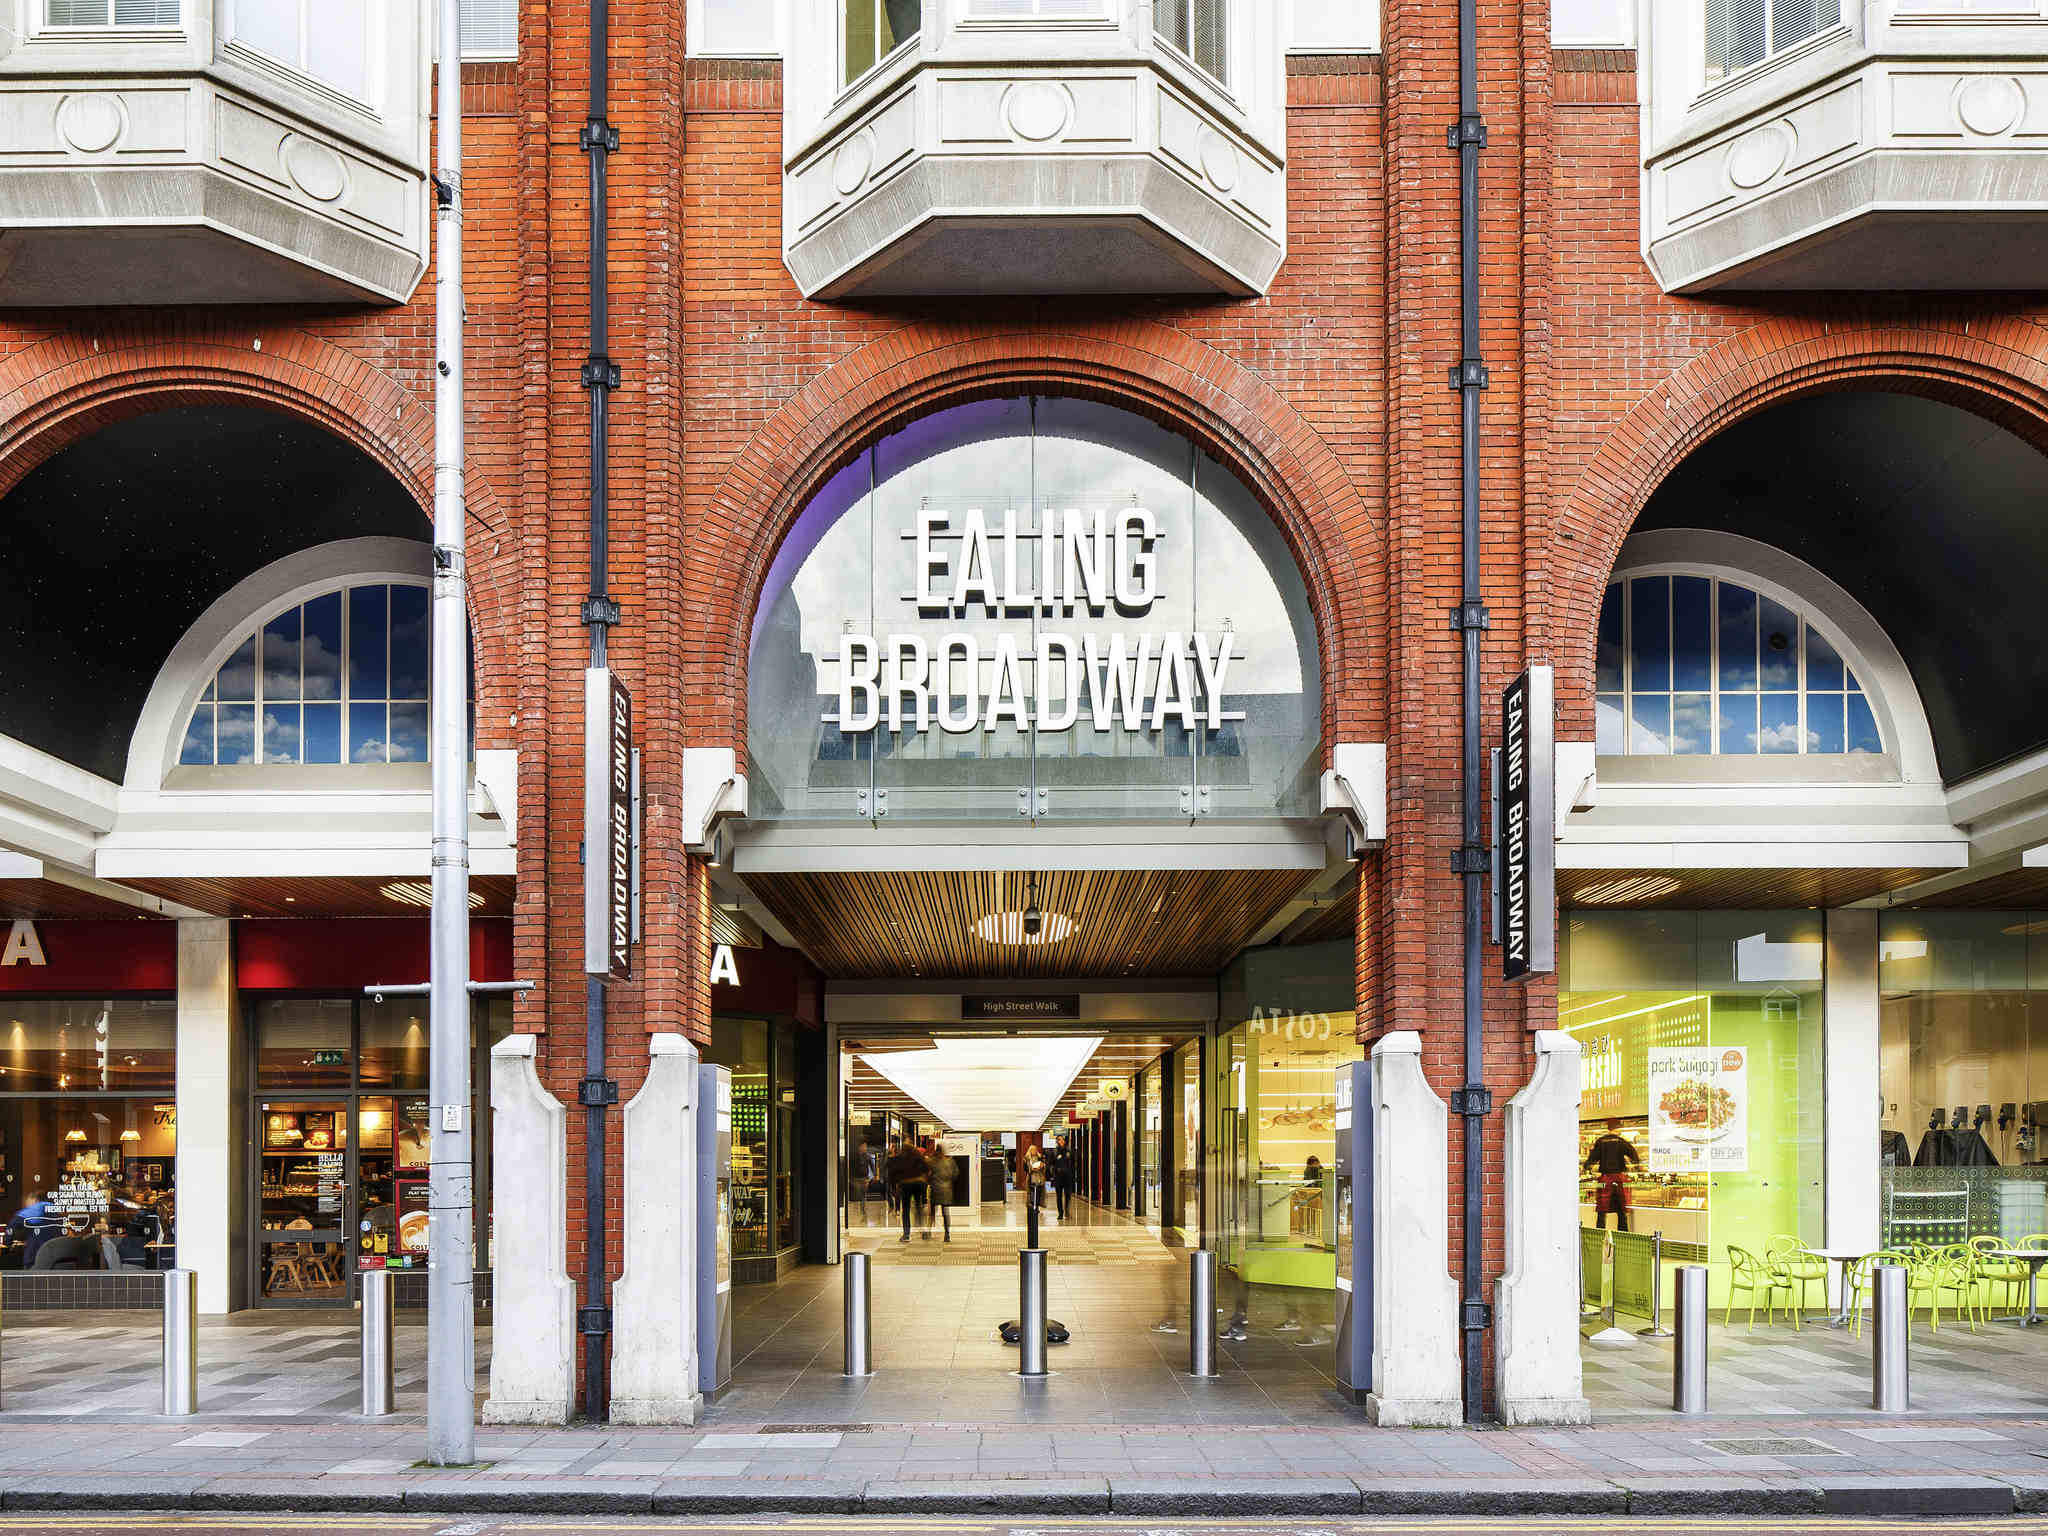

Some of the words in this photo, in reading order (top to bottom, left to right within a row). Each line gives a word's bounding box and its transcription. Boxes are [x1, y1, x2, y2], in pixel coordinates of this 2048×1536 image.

[917, 508, 1157, 612] EALING
[838, 632, 1234, 734] BROADWAY
[615, 689, 627, 794] EALING
[1508, 688, 1523, 793] EALING
[614, 803, 627, 967] BROADWAY
[1508, 799, 1523, 962] BROADWAY
[983, 1001, 1004, 1013] High
[1006, 1001, 1034, 1011] Street
[1035, 1001, 1059, 1011] Walk
[1651, 1056, 1676, 1080] pork
